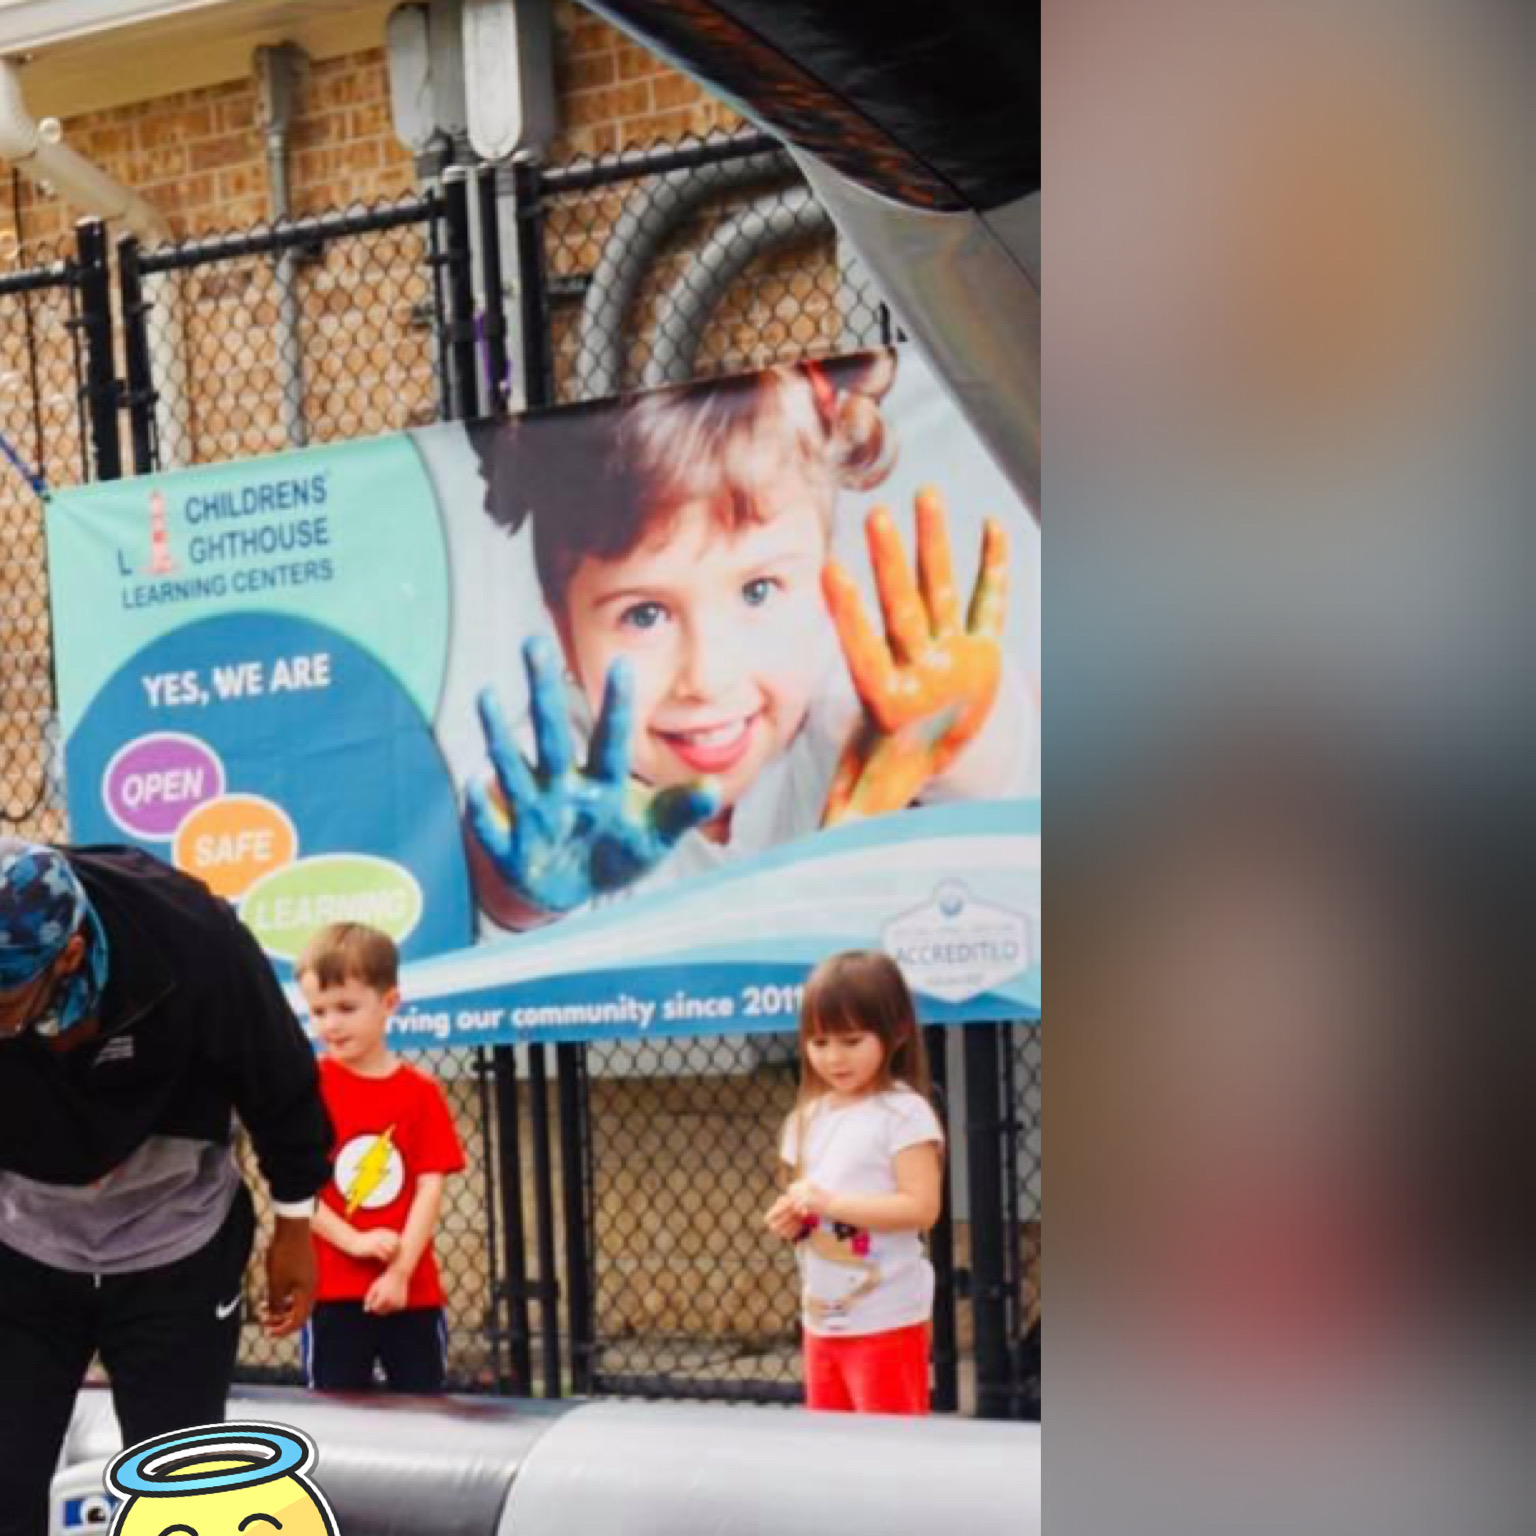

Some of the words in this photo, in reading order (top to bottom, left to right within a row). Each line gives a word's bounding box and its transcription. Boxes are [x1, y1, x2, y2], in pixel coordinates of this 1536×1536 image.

[185, 475, 328, 524] CHILDRENS
[122, 575, 227, 609] LEARNING
[232, 558, 333, 592] CENTERS
[142, 670, 210, 707] YES,
[212, 662, 263, 700] WE
[270, 653, 332, 693] ARE
[122, 767, 204, 808] OPEN
[195, 828, 273, 867] SAFE
[257, 885, 407, 931] LEARNING
[385, 1006, 450, 1038] rving
[457, 1008, 504, 1030] our
[512, 994, 657, 1029] community
[663, 989, 735, 1020] since
